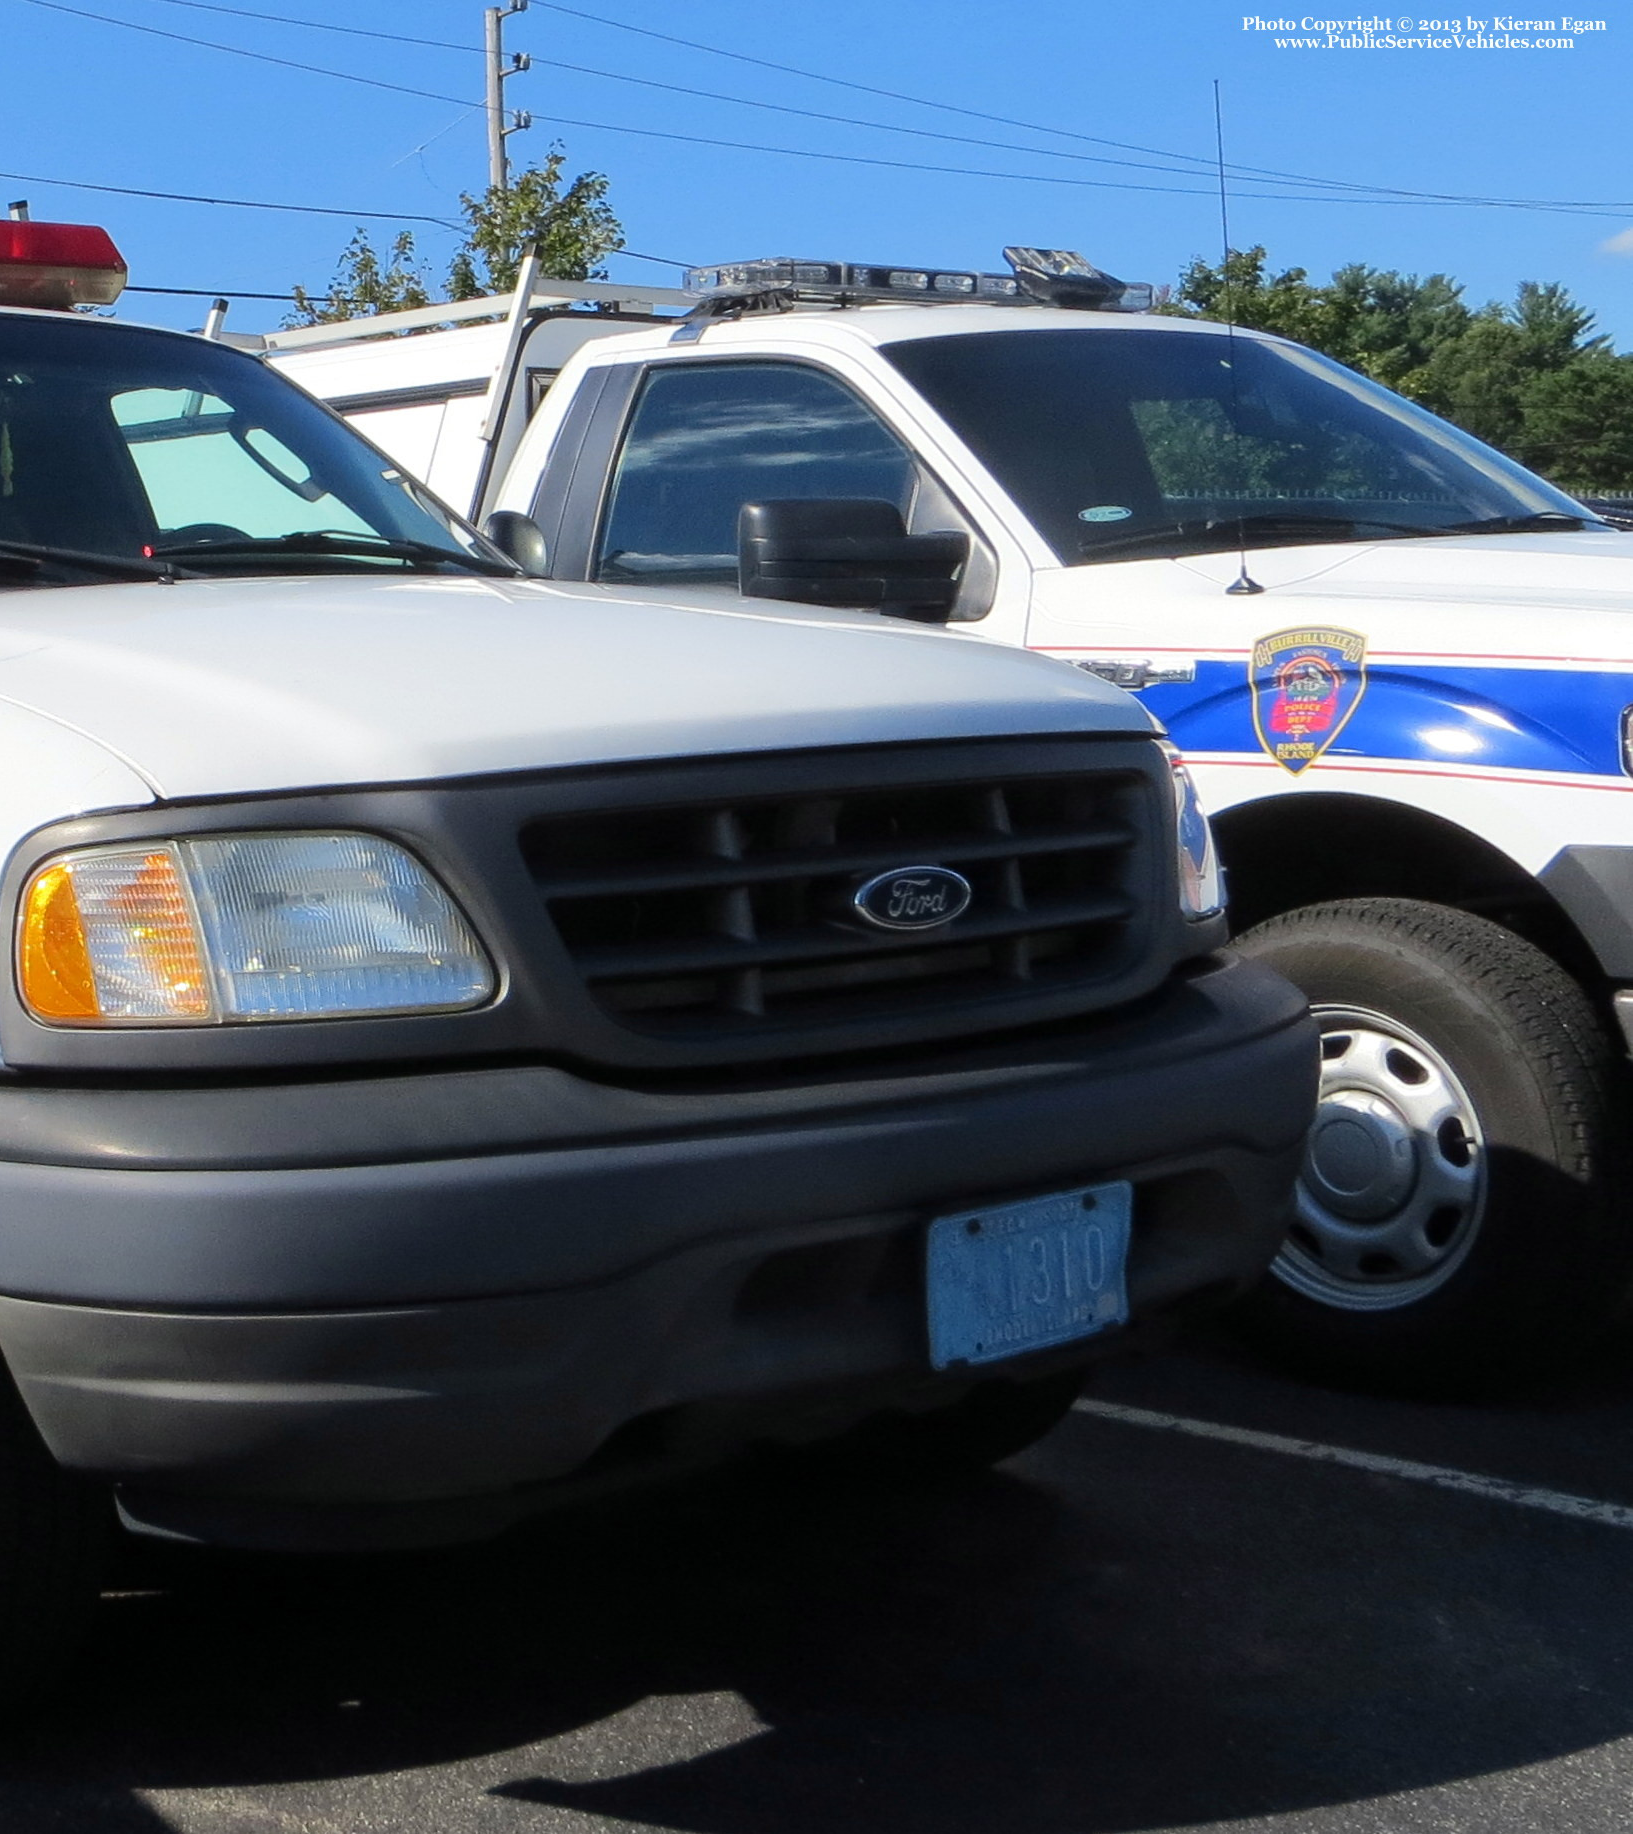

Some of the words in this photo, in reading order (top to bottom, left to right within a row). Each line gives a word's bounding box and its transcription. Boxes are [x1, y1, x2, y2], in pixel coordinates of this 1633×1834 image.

[1270, 632, 1350, 650] BURRILLVILLE
[1284, 703, 1321, 713] POLICE
[1277, 742, 1316, 751] RHODE
[1277, 750, 1316, 760] ISLAND
[887, 878, 948, 918] Ford
[1005, 1224, 1105, 1312] 1310
